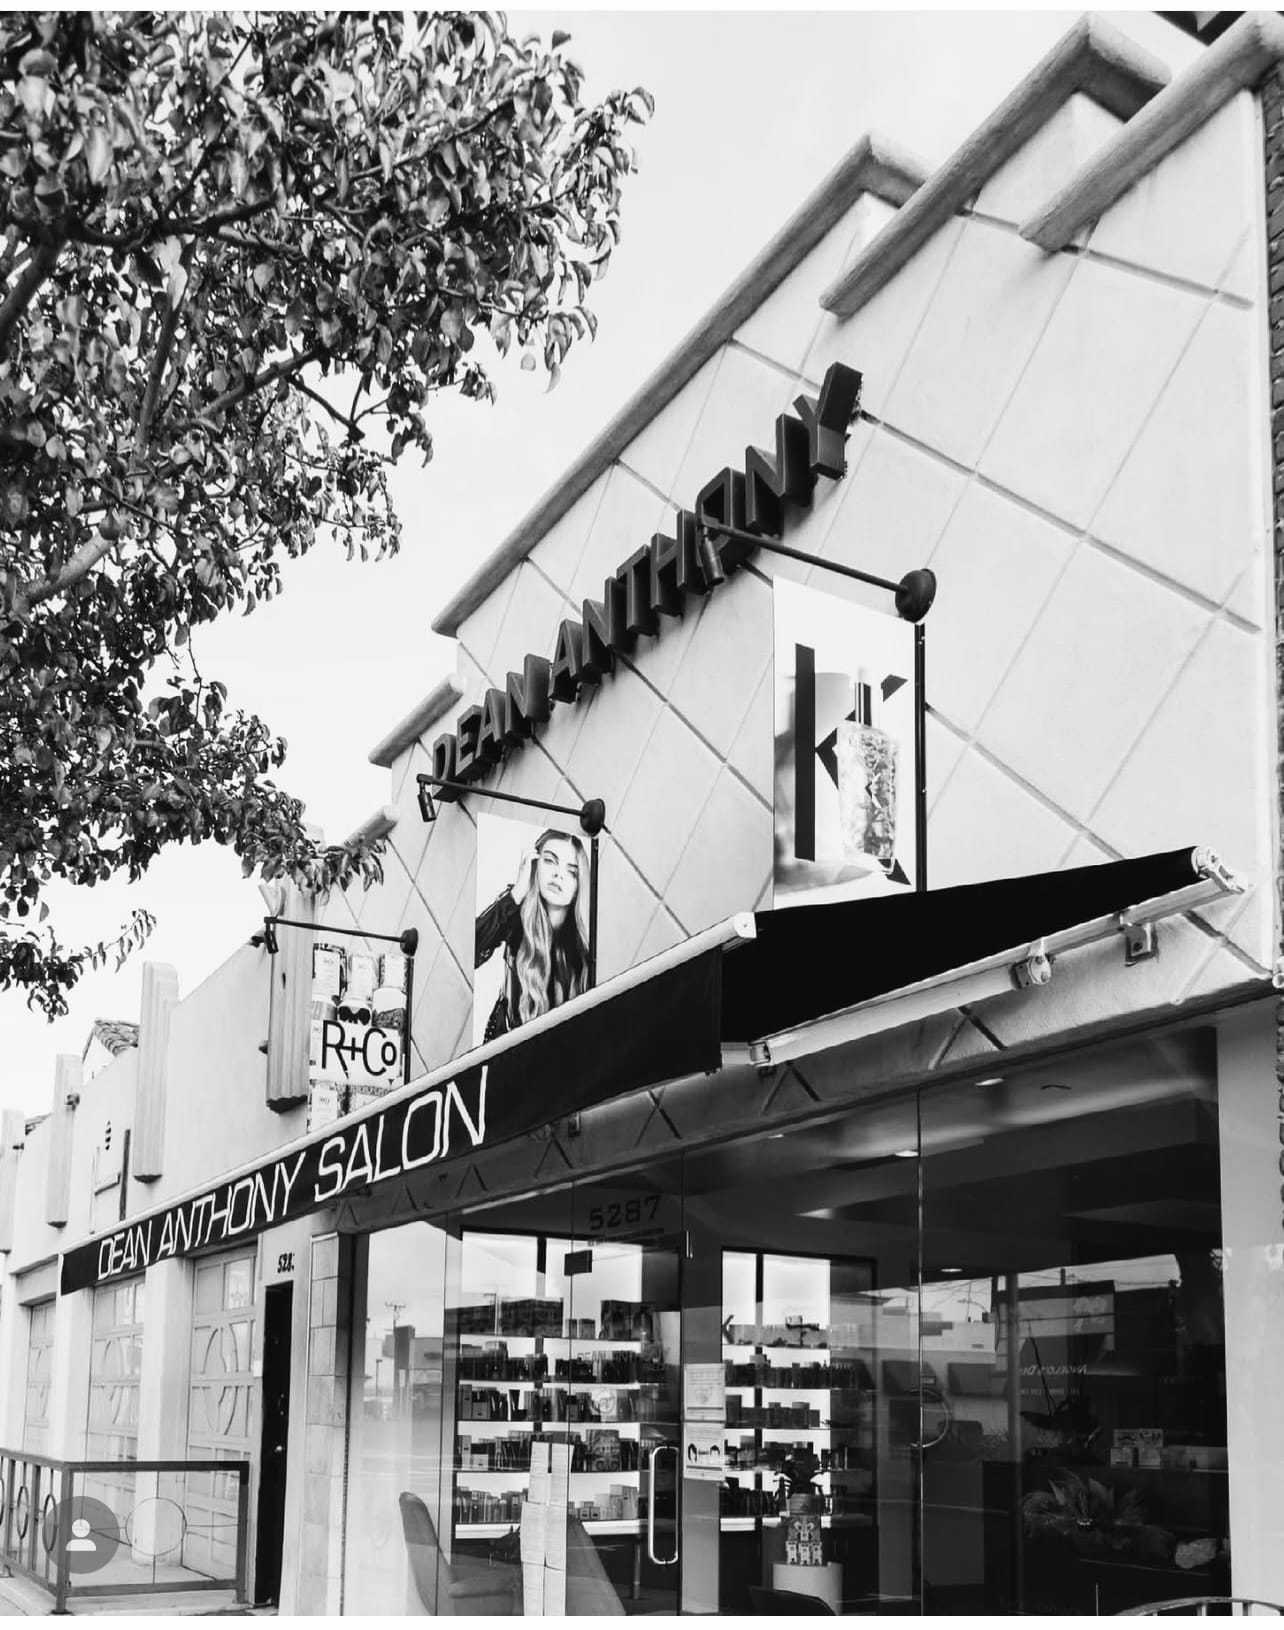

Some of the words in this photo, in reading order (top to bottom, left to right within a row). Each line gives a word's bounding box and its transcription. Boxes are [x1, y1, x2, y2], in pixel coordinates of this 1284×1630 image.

[431, 653, 553, 803] DEAN
[549, 361, 864, 704] ANTHONY
[321, 1019, 398, 1078] R+Co
[97, 1219, 152, 1281] DEAN
[156, 1151, 306, 1261] ANTHONY
[314, 1065, 489, 1203] SALON
[589, 1195, 662, 1231] 5287
